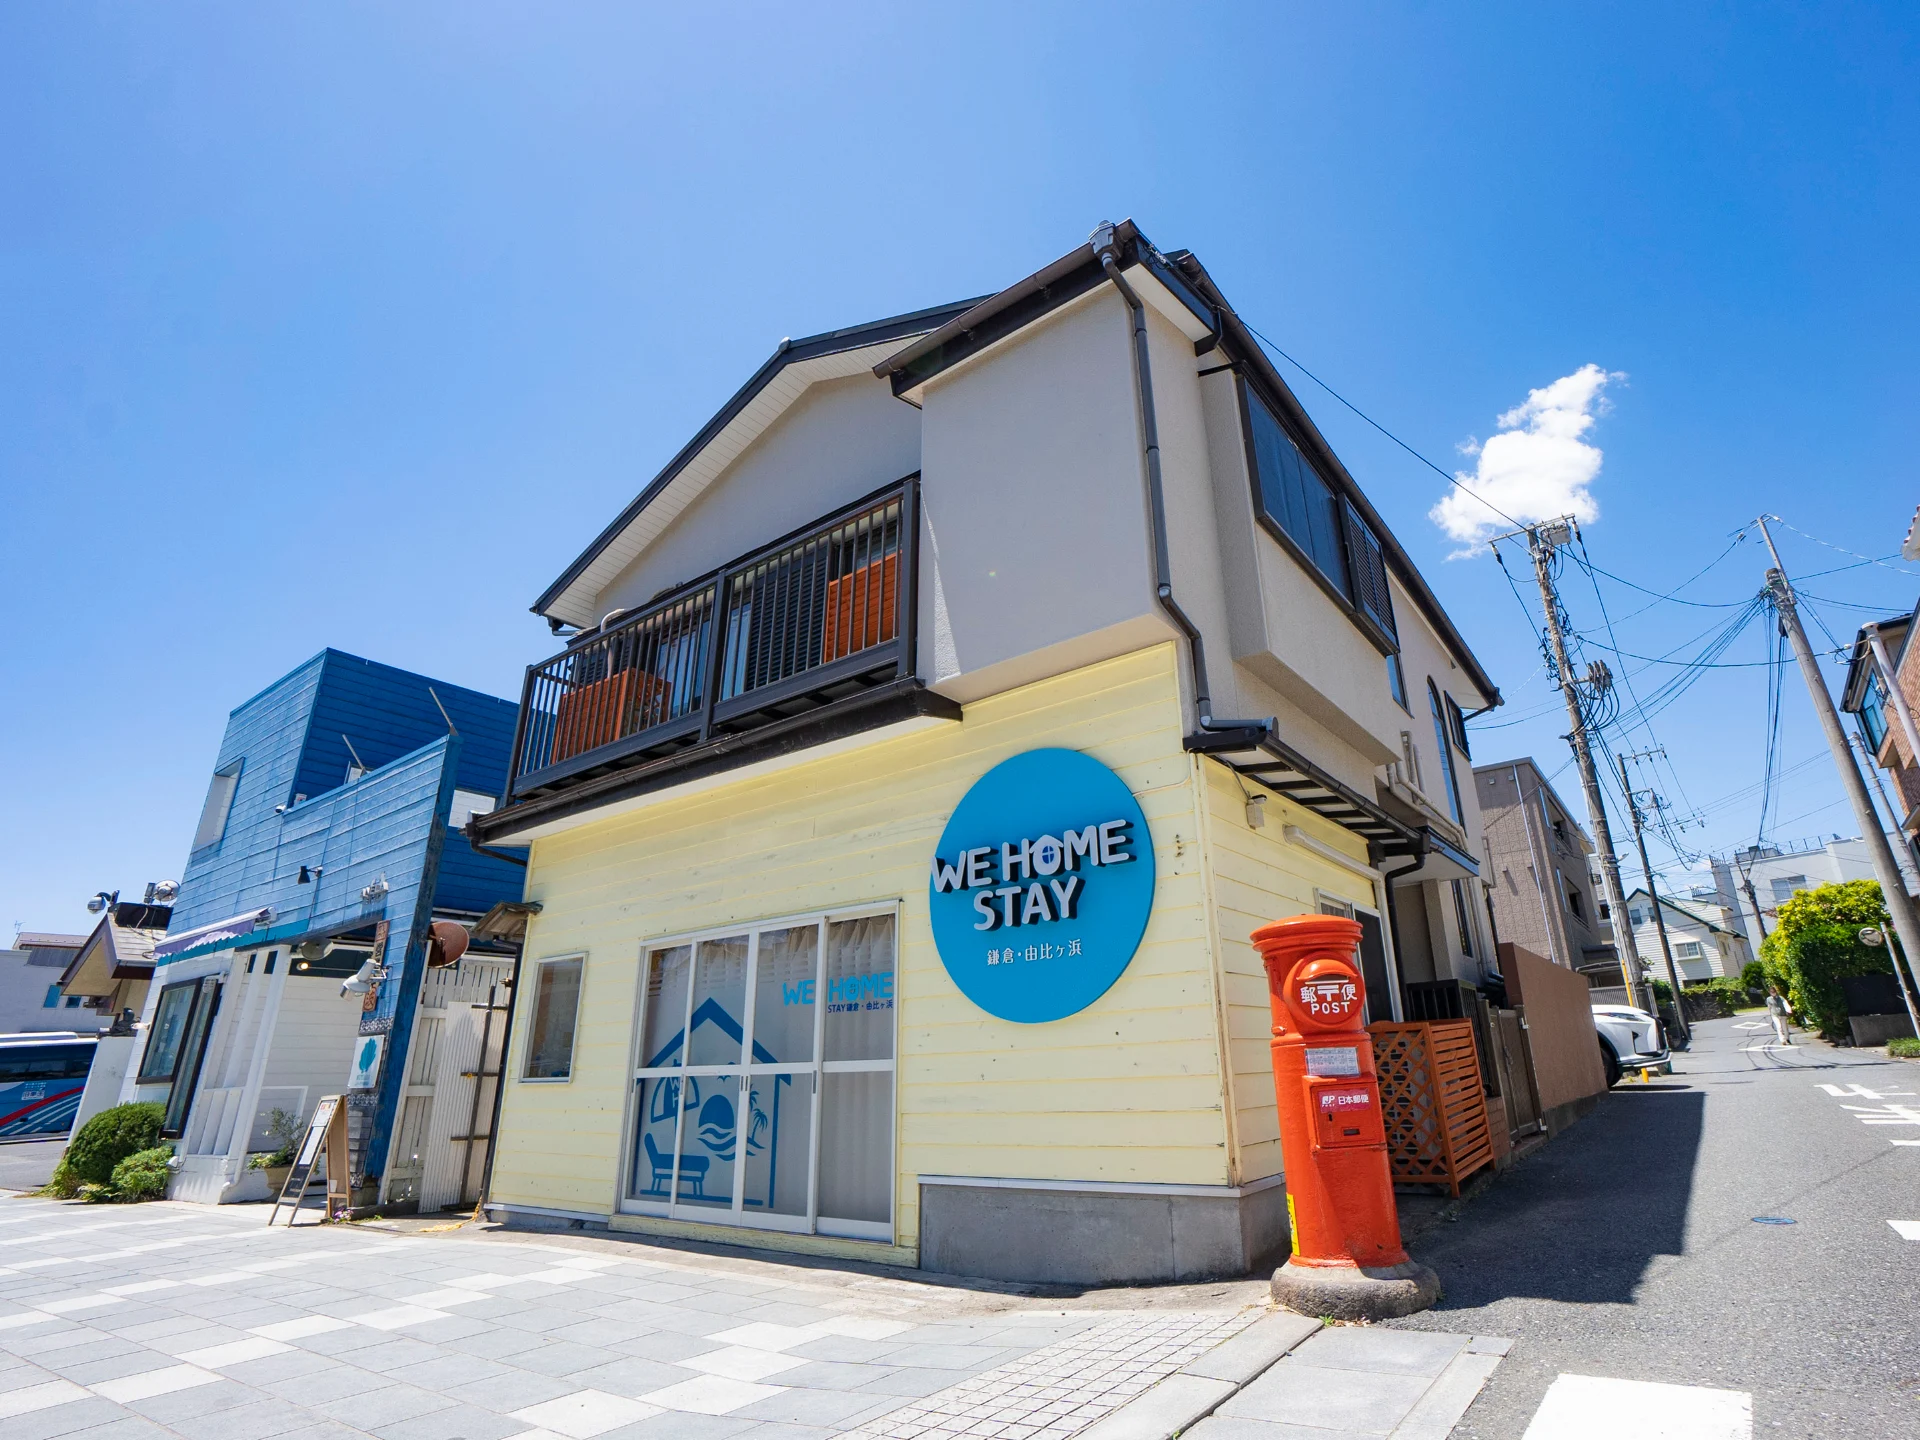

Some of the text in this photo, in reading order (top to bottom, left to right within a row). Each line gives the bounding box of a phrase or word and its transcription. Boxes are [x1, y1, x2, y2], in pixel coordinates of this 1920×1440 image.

[931, 819, 1134, 893] WE HOME
[973, 876, 1083, 931] STAY
[782, 971, 894, 1007] WE HOME
[1311, 1001, 1351, 1015] POST
[1337, 1093, 1369, 1105] 日本郵便
